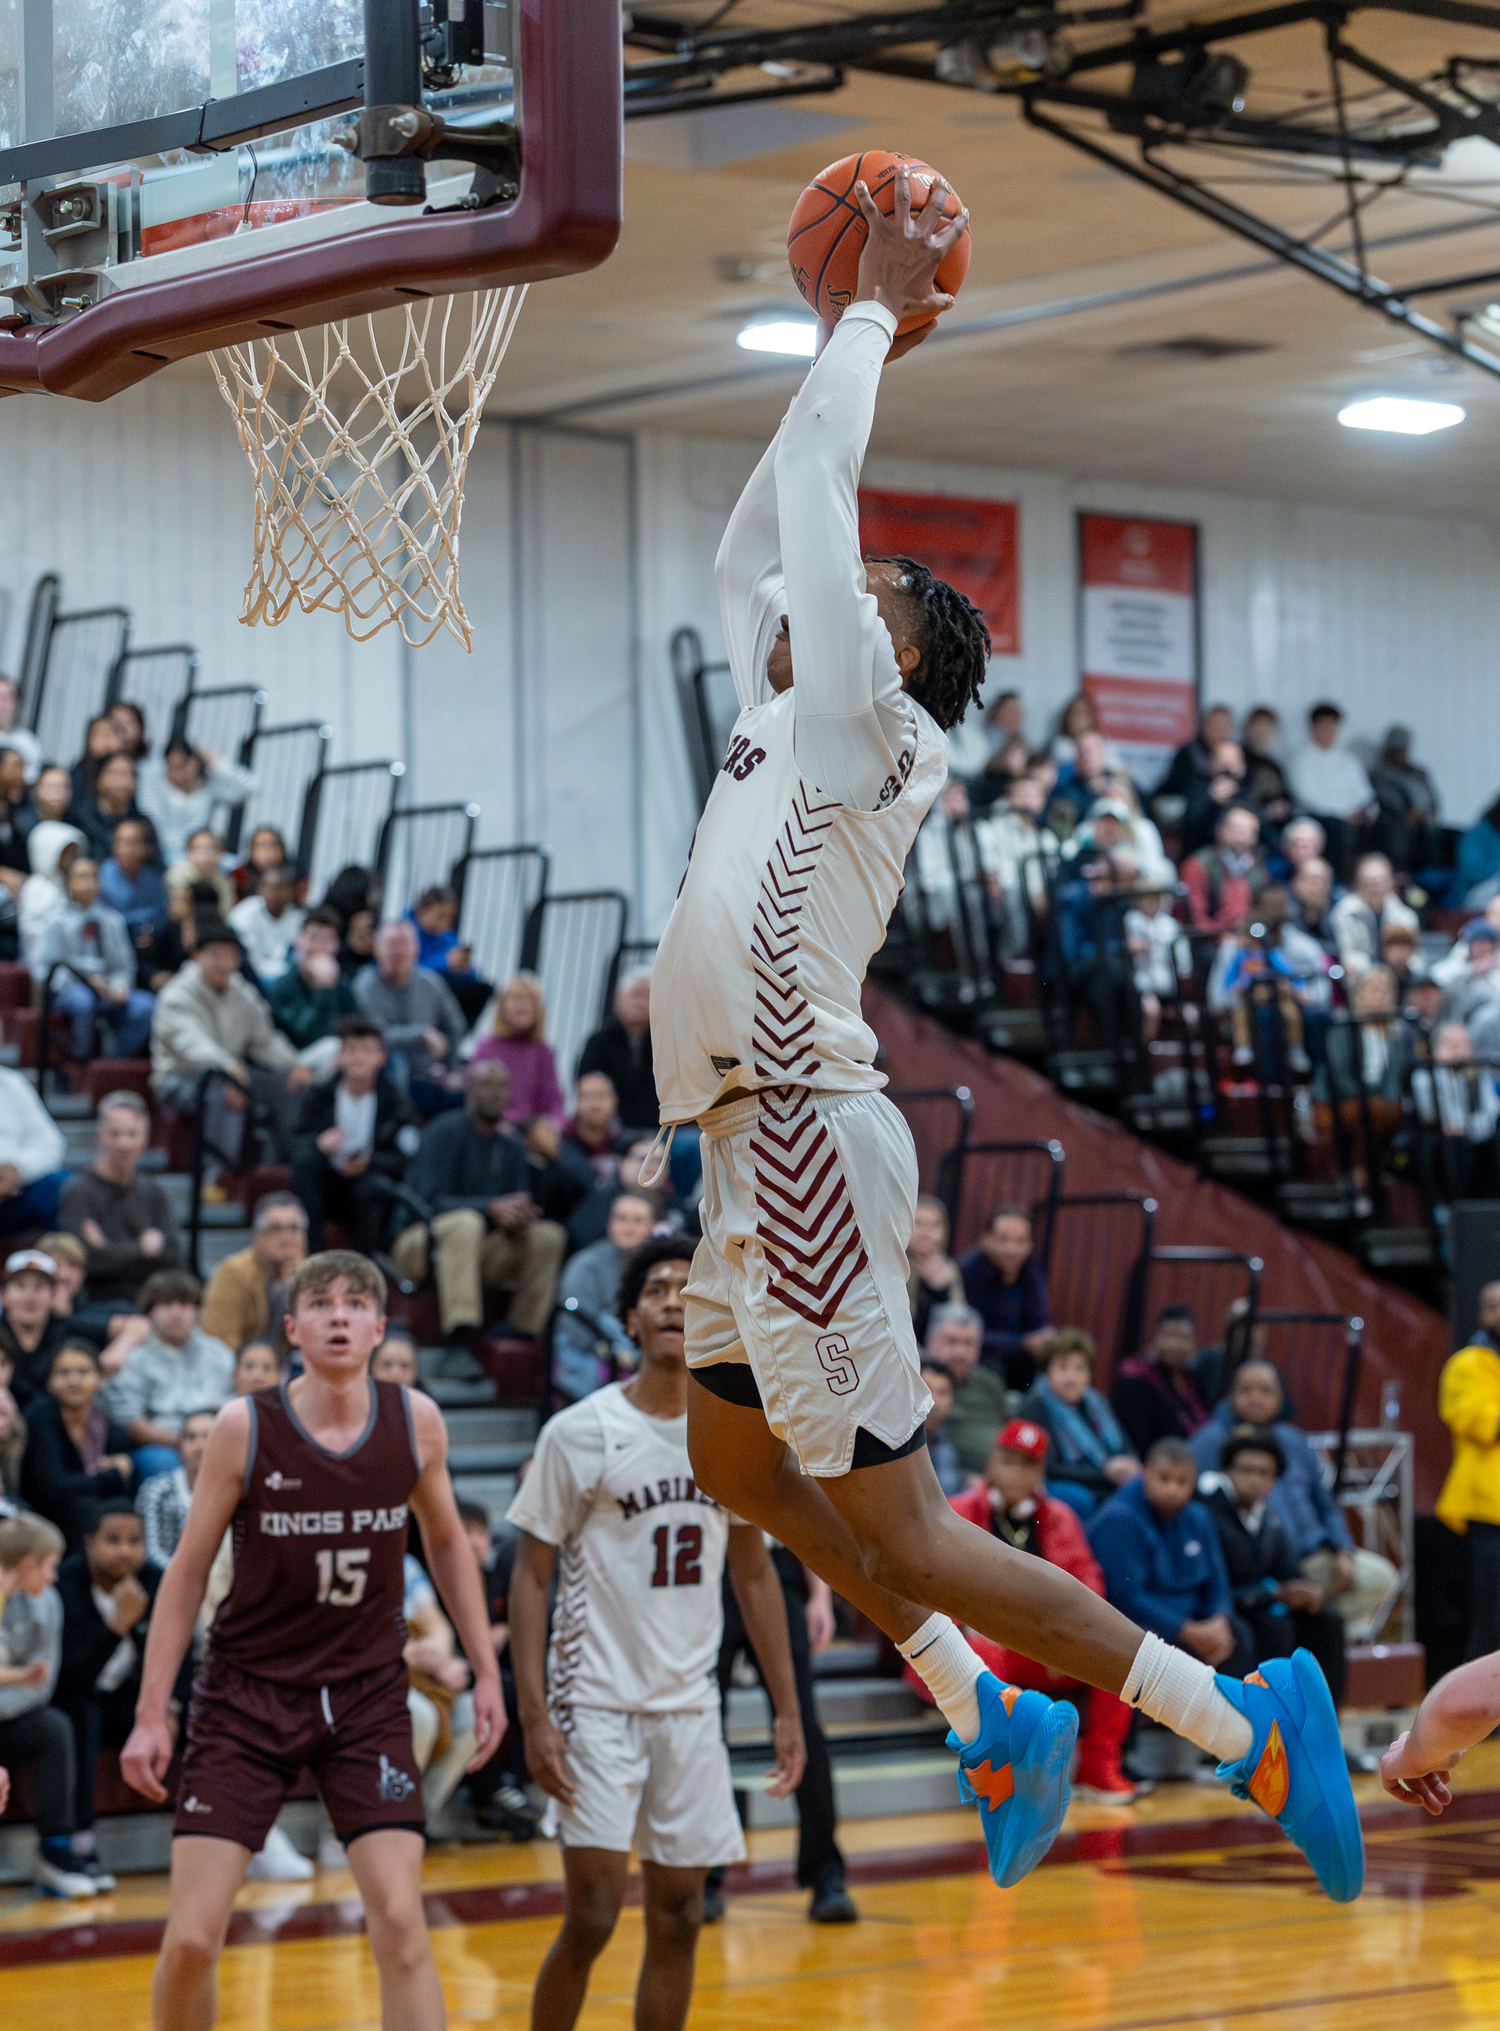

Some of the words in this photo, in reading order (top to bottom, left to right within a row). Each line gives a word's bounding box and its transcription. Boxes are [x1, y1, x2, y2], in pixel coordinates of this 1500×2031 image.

[815, 1332, 860, 1396] S
[315, 1547, 371, 1607] 15
[650, 1524, 704, 1588] 12
